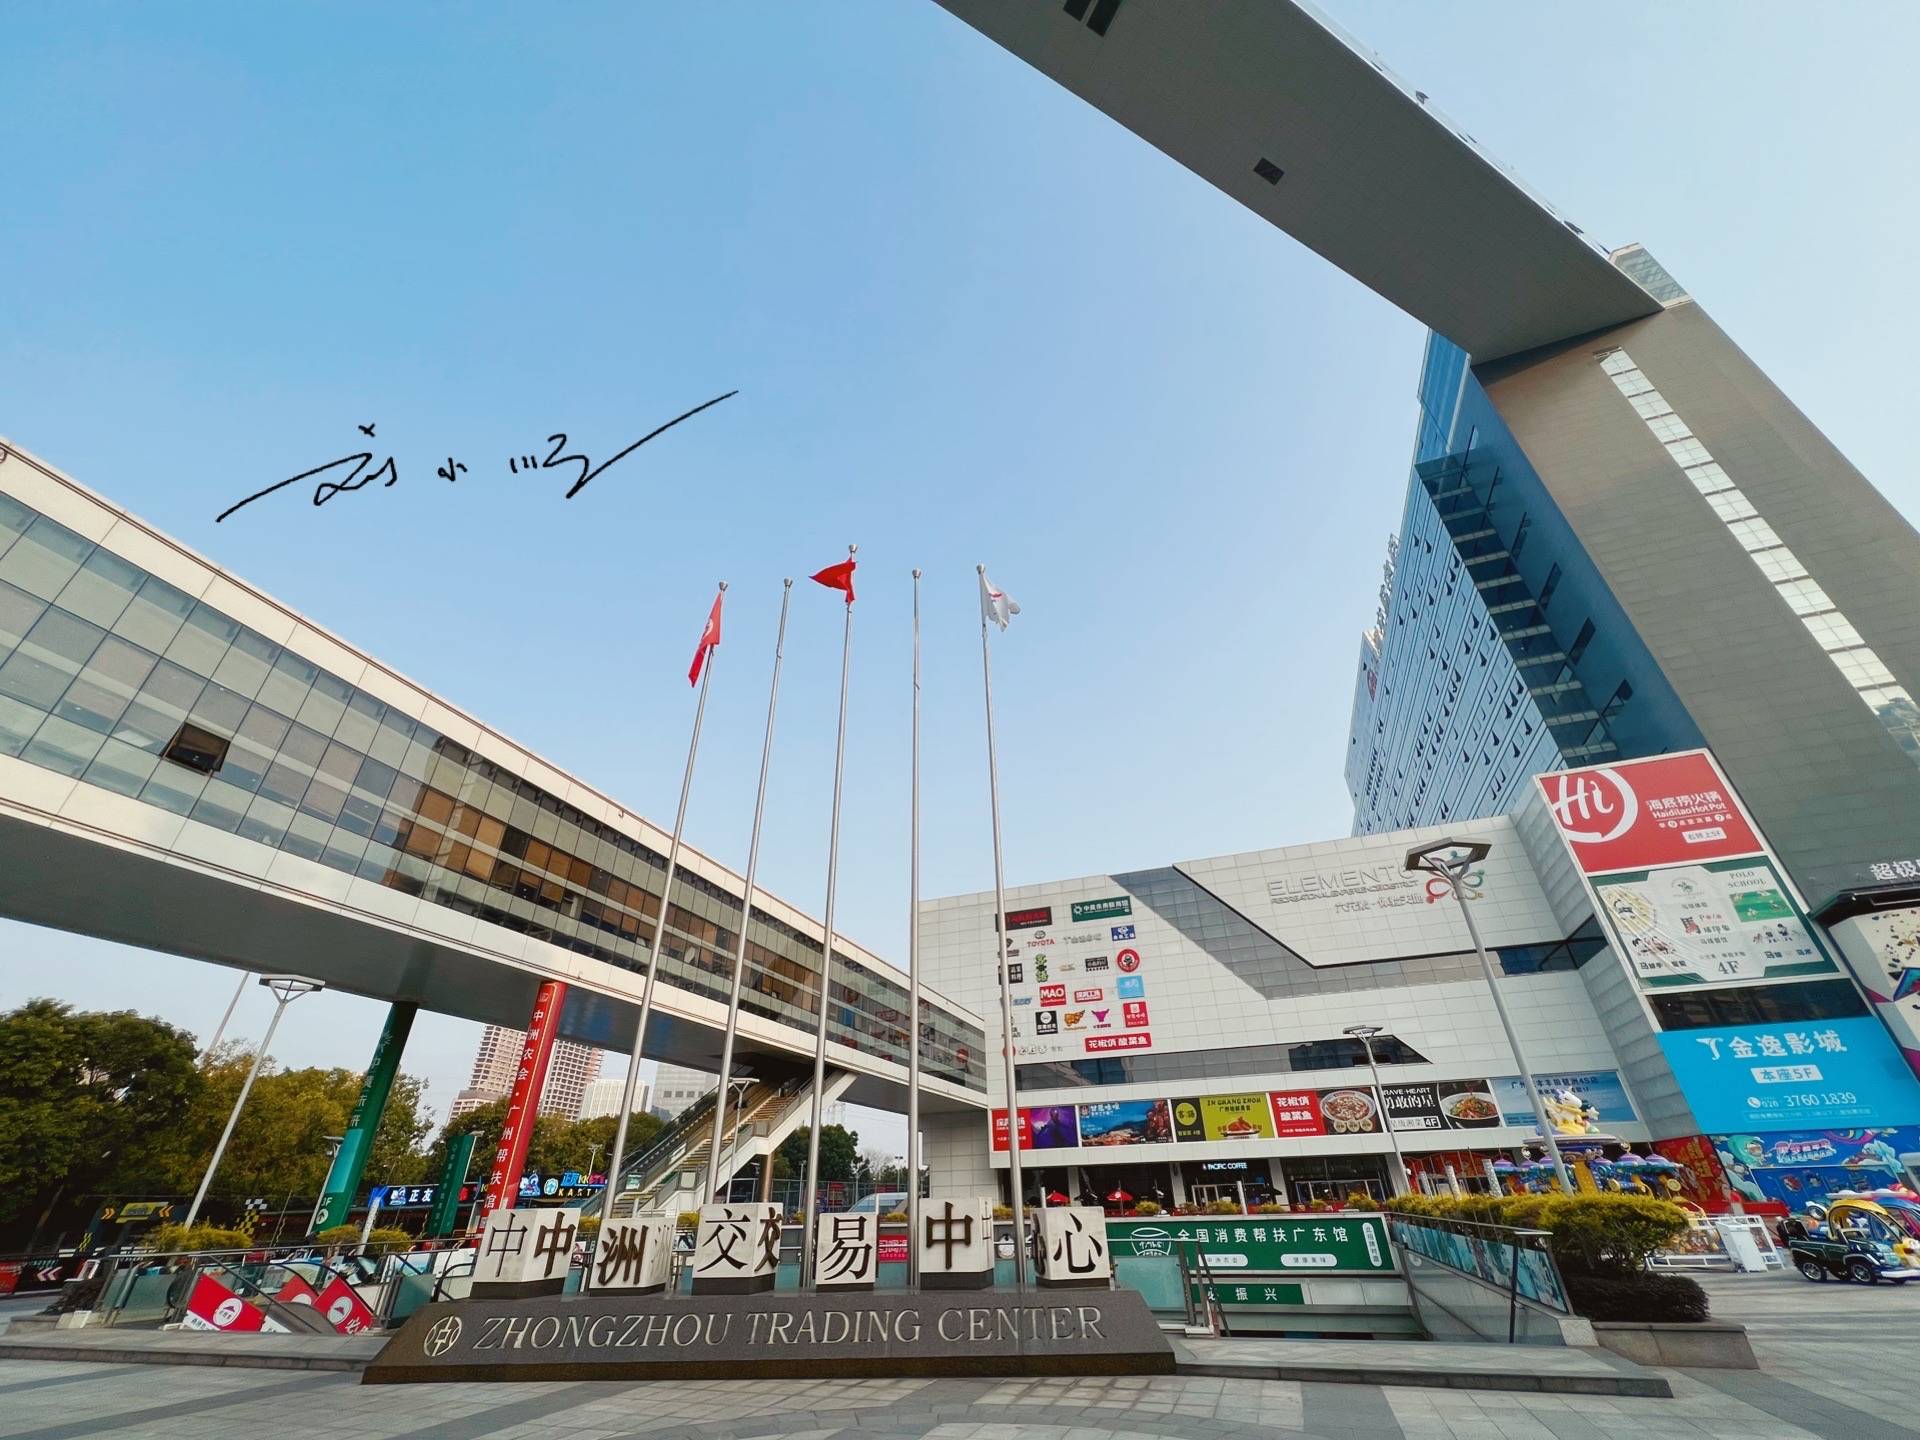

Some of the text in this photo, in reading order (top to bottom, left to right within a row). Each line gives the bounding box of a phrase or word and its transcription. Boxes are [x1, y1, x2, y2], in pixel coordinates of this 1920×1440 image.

[1552, 775, 1614, 826] Hi
[1647, 791, 1722, 811] 海底捞火锅
[1652, 801, 1727, 819] Haidilao Hot Pot
[1729, 870, 1756, 880] POLO
[1869, 859, 1920, 880] 超级
[1727, 878, 1767, 888] SCHOOL
[1027, 939, 1055, 948] TOYOTA
[1717, 960, 1741, 975] 4F
[1040, 986, 1065, 999] MAO
[1728, 1030, 1847, 1058] 金逸影城
[1759, 1067, 1813, 1081] 本座5F
[1784, 1094, 1820, 1107] 3760
[1821, 1091, 1857, 1105] 1839
[1280, 1110, 1313, 1121] 酸菜鱼
[1425, 1118, 1438, 1127] 4F
[409, 1188, 434, 1202] 正友
[698, 1208, 751, 1272] 交
[820, 1216, 873, 1280] 易
[926, 1201, 974, 1270] 中
[1053, 1212, 1103, 1273] 心
[1178, 1227, 1349, 1243] 全国消费帮扶广东馆
[473, 1305, 1107, 1350] ZHONGZHOU TRADING CENTER
